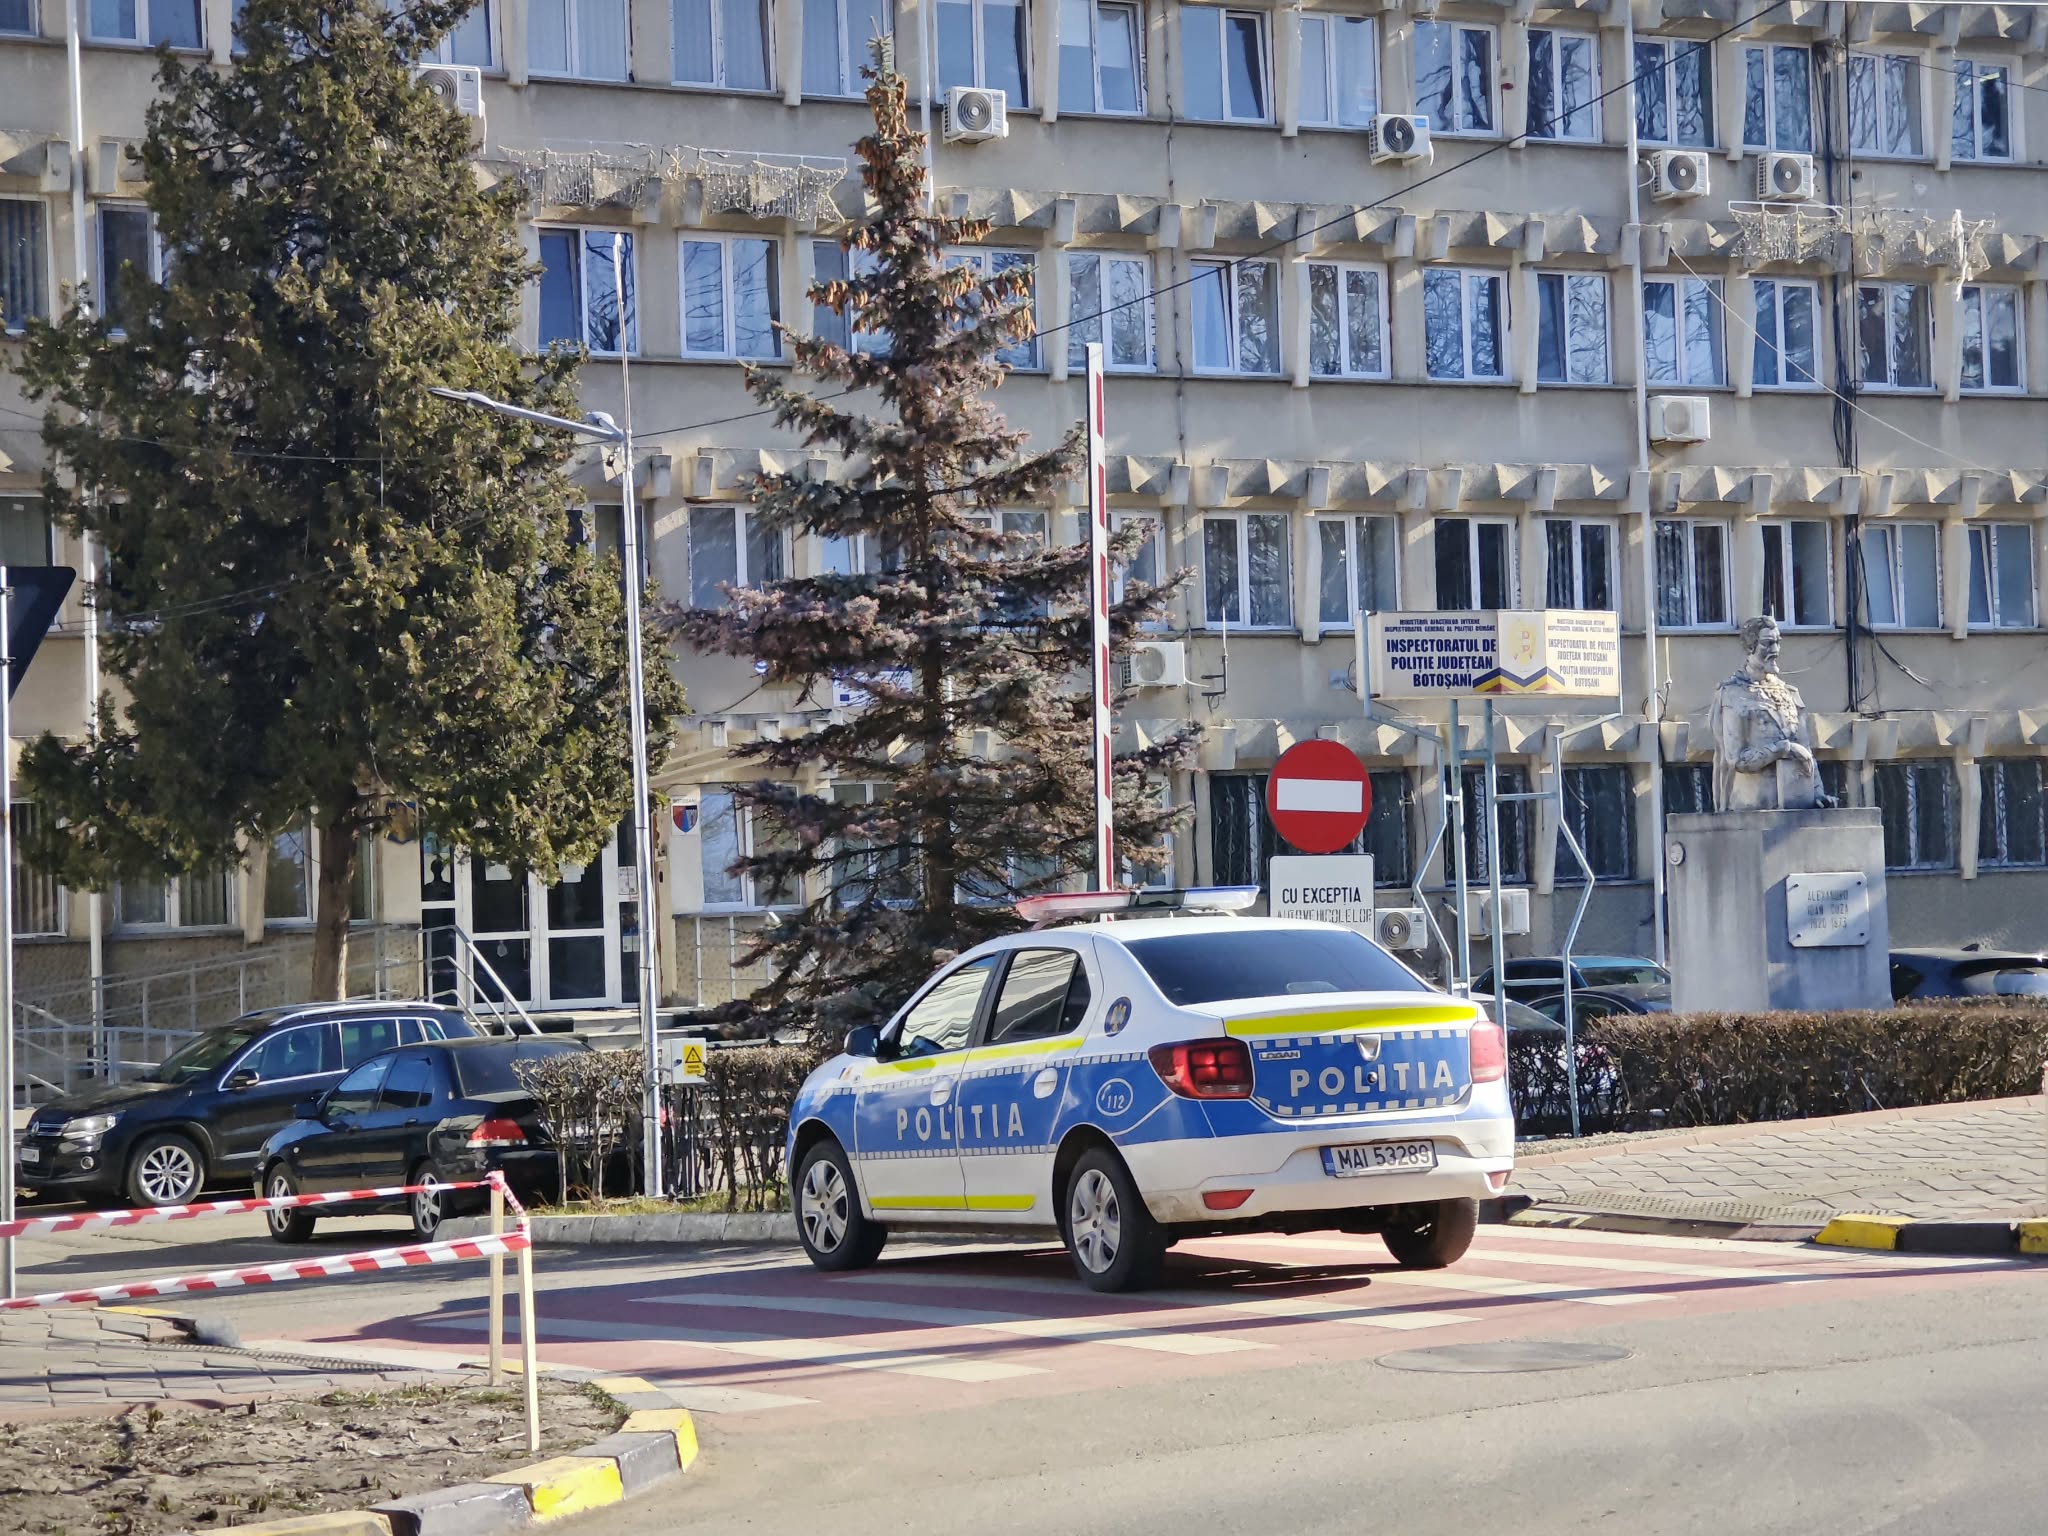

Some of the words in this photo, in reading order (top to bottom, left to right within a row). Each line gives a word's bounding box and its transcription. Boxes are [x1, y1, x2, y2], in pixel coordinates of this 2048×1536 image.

[1386, 639, 1479, 653] INSPECTORATUL
[1482, 638, 1497, 652] DE
[1282, 888, 1298, 904] CU
[1290, 1060, 1454, 1098] POLITIA
[1107, 1094, 1125, 1109] 112
[896, 1102, 1025, 1142] POLITIA
[1338, 1148, 1369, 1170] MAI
[1373, 1144, 1431, 1167] 53289
